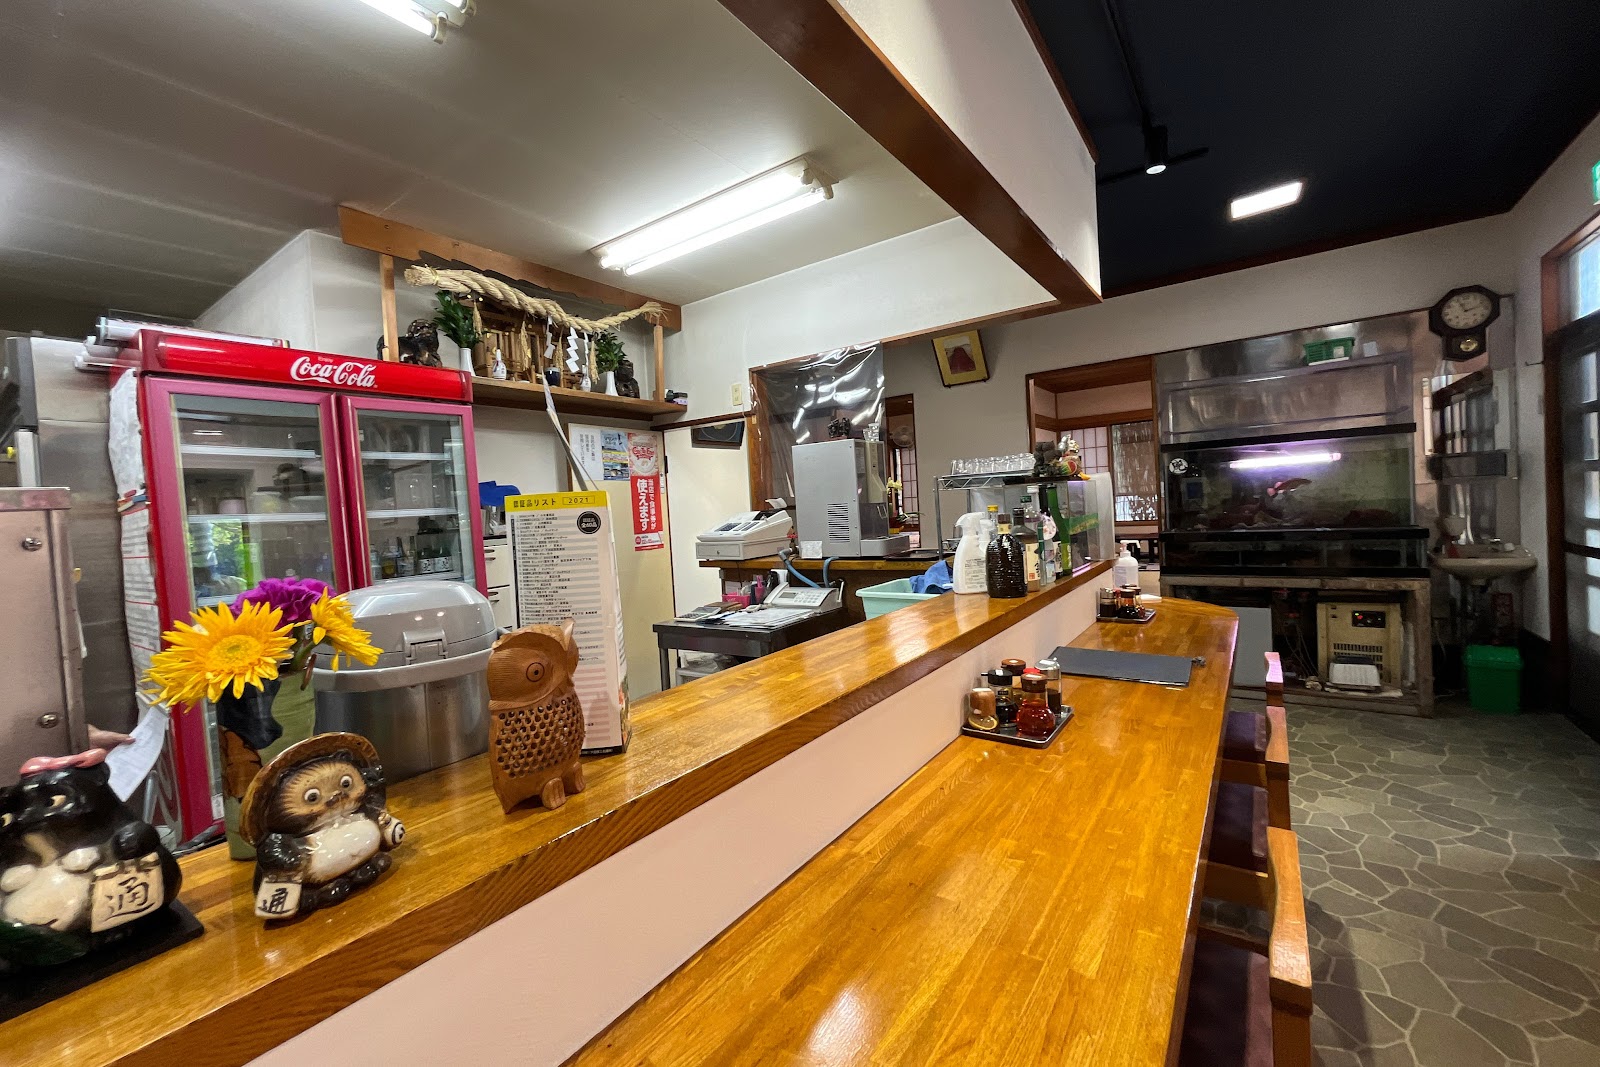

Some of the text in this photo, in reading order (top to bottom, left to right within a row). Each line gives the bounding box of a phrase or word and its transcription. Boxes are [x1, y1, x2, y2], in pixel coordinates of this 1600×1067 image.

[290, 356, 377, 388] Coca-Cola
[632, 446, 641, 455] Go
[513, 498, 557, 508] 認証品リスト
[636, 478, 650, 531] 使えます
[104, 876, 156, 922] 通
[257, 887, 296, 914] 通
